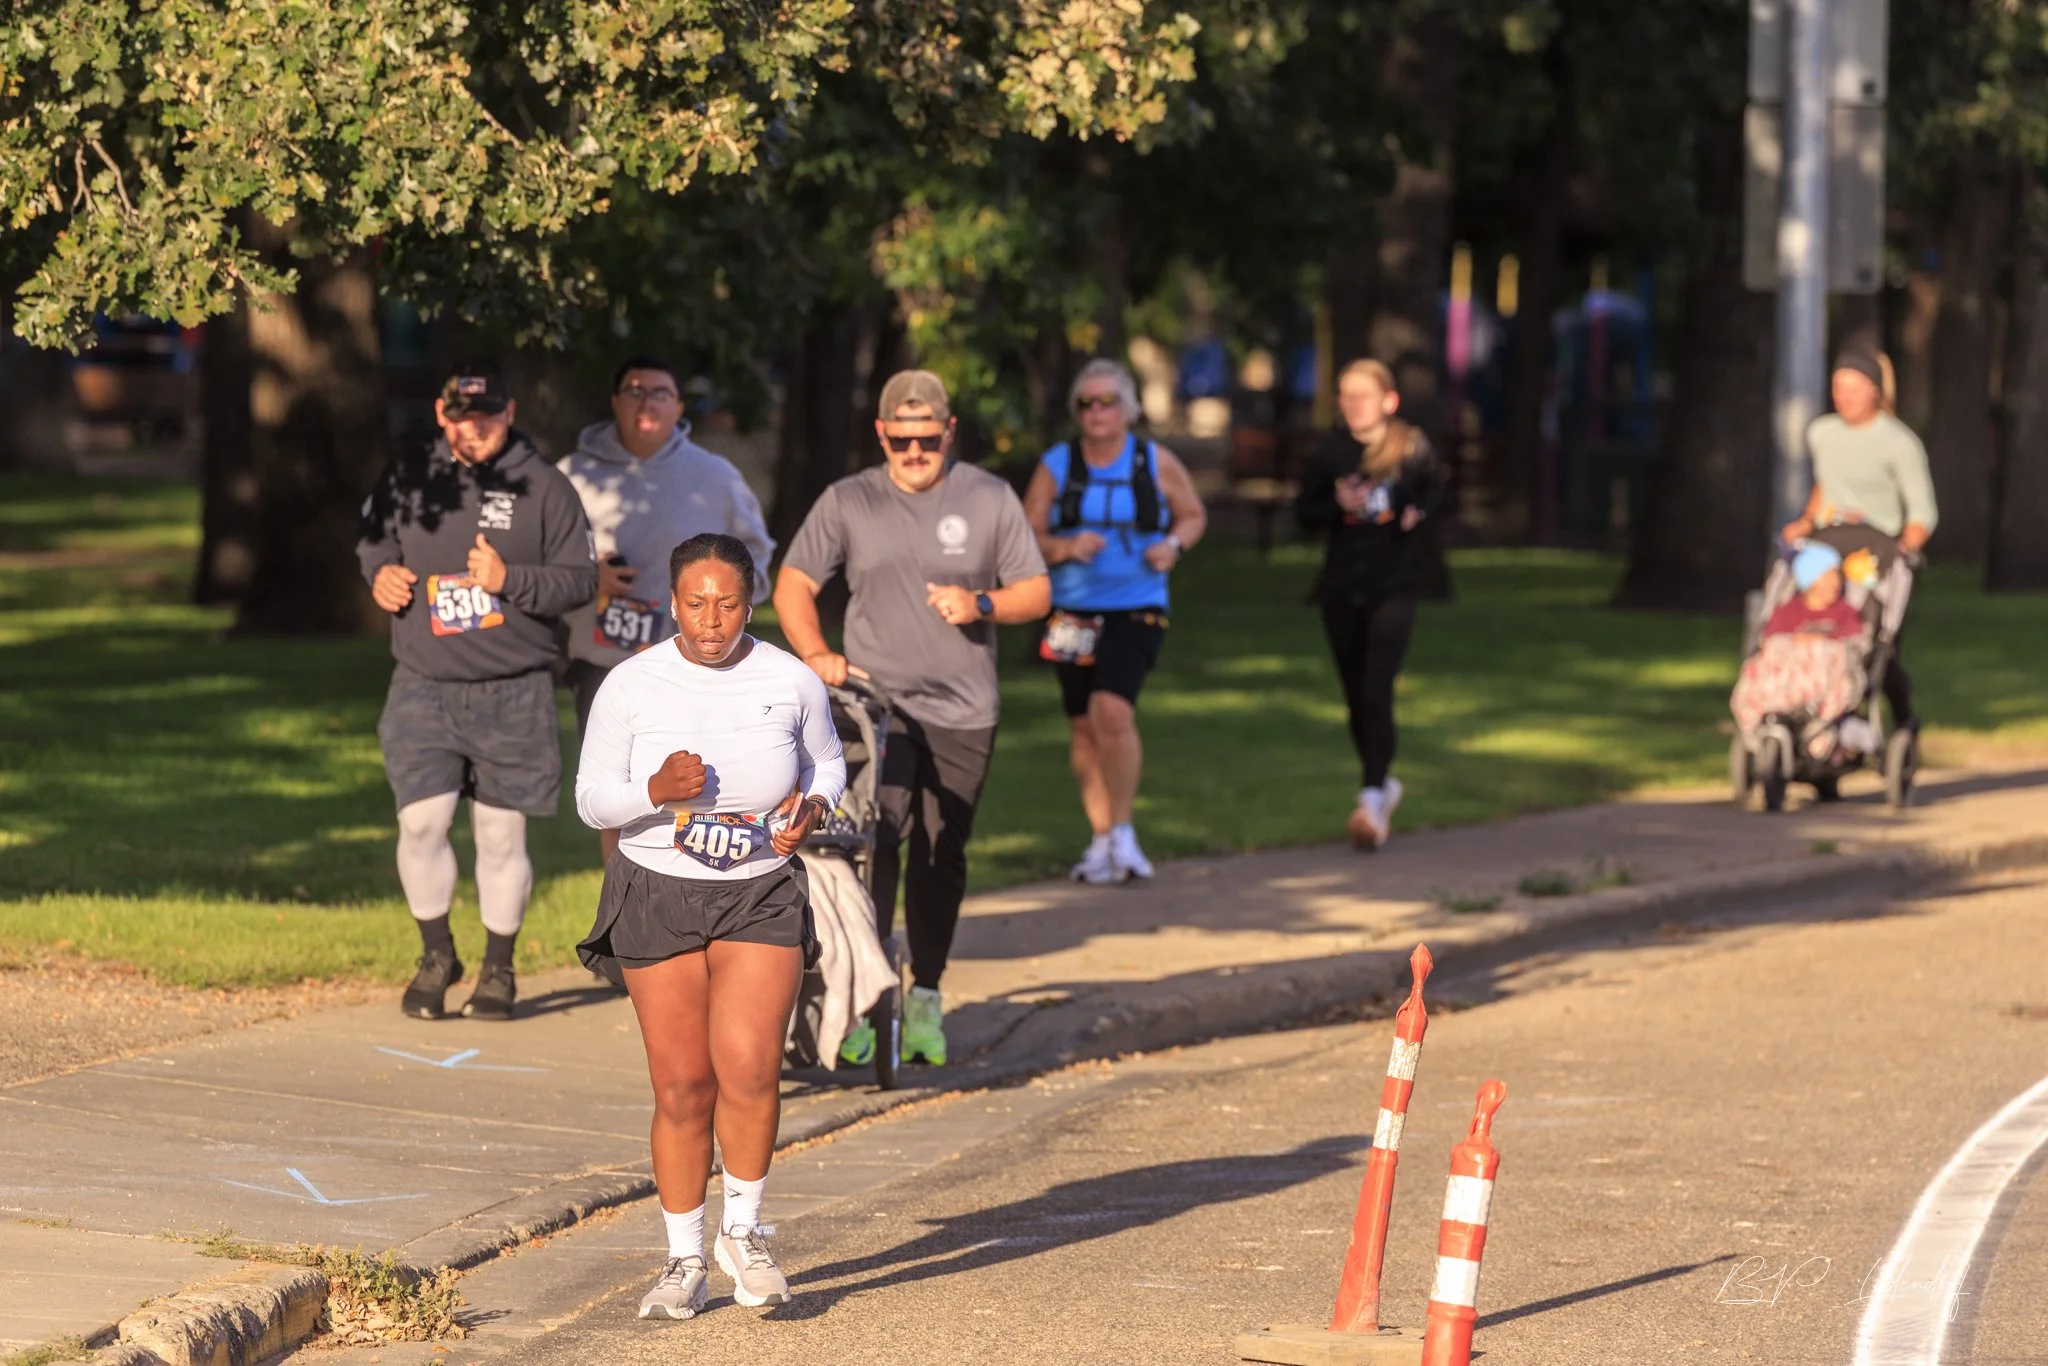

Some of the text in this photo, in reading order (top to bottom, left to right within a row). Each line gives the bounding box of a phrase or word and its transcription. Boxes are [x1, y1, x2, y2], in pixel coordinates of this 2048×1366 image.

[437, 585, 492, 622] 530
[604, 607, 653, 643] 531
[683, 823, 752, 860] 405
[708, 858, 720, 867] 5K
